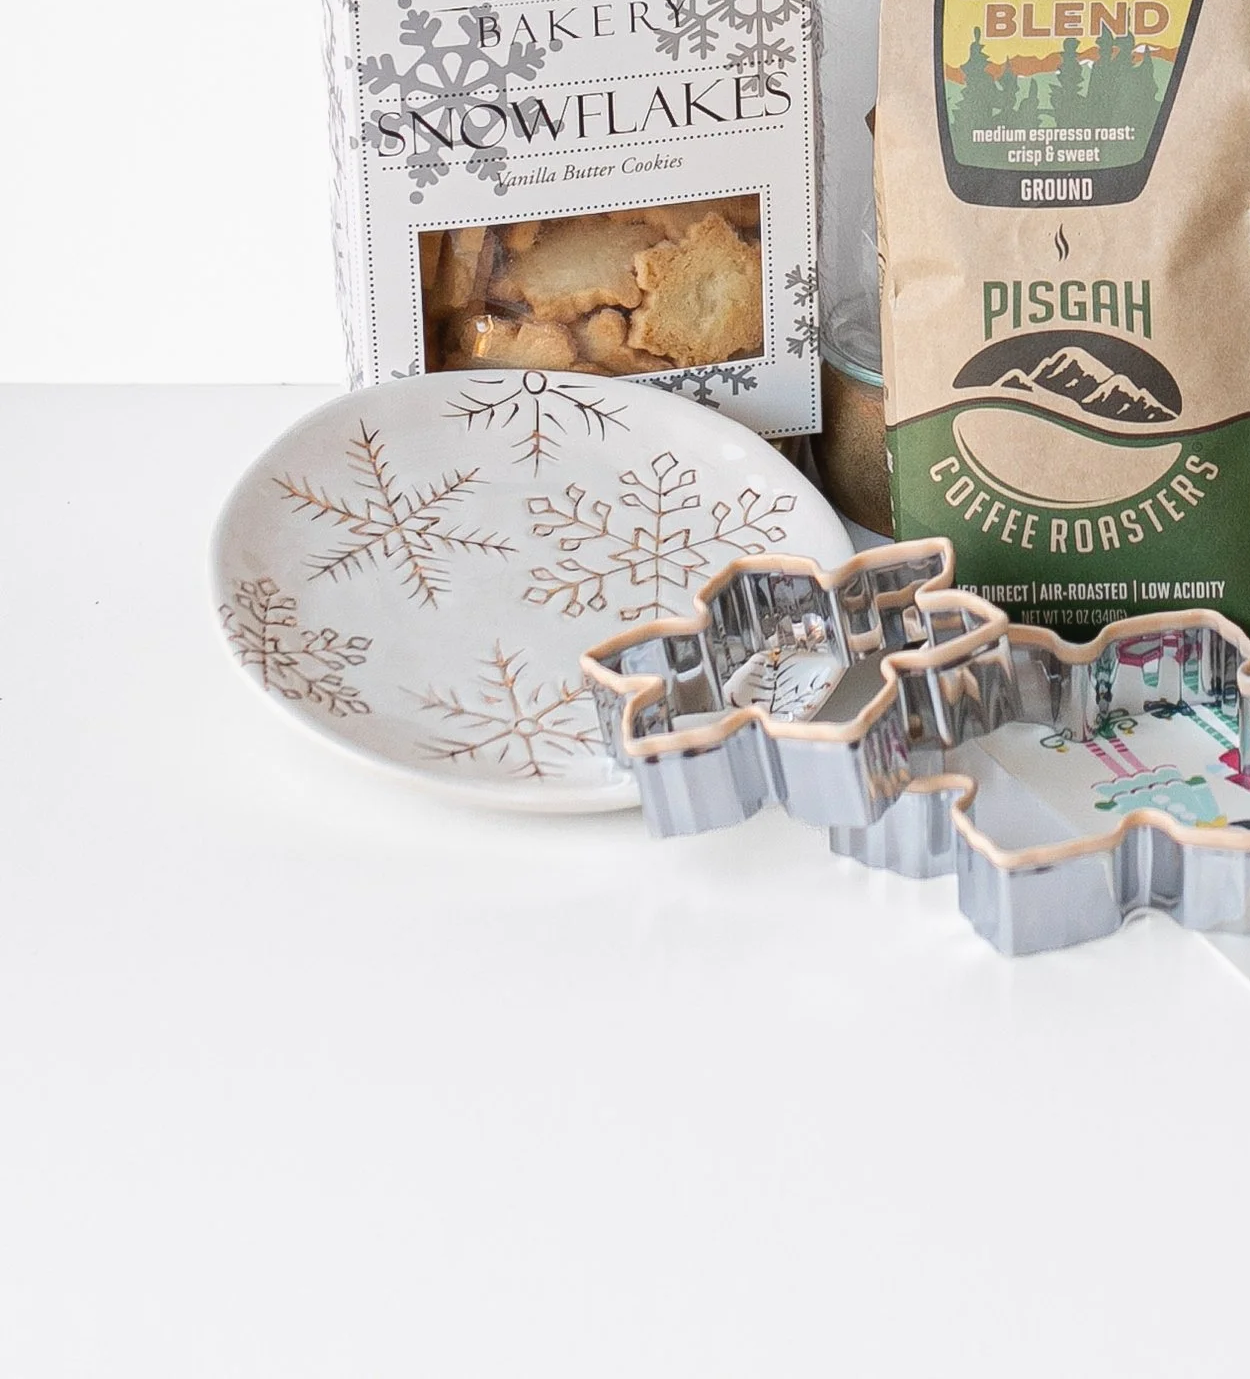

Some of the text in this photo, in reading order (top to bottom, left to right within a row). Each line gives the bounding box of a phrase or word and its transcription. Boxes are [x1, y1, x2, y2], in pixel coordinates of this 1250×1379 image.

[985, 1, 1171, 39] BLEND
[376, 71, 792, 158] SNOWFLAKES
[972, 125, 1135, 145] medium espresso roast:
[1008, 145, 1100, 166] crisp & sweet
[496, 154, 684, 188] Vanilla Butter Cookies
[1021, 178, 1093, 201] GROUND
[983, 280, 1151, 340] PISGAH
[929, 455, 1219, 553] COFFEE ROASTERS
[982, 584, 1029, 603] DIRECT
[1040, 582, 1128, 601] AIR-ROASTED
[1142, 582, 1171, 600] LOW
[1174, 581, 1225, 599] ACIDITY
[1021, 610, 1040, 625] NET
[1043, 610, 1060, 624] WT
[1062, 609, 1073, 624] 12
[1076, 609, 1089, 624] OZ
